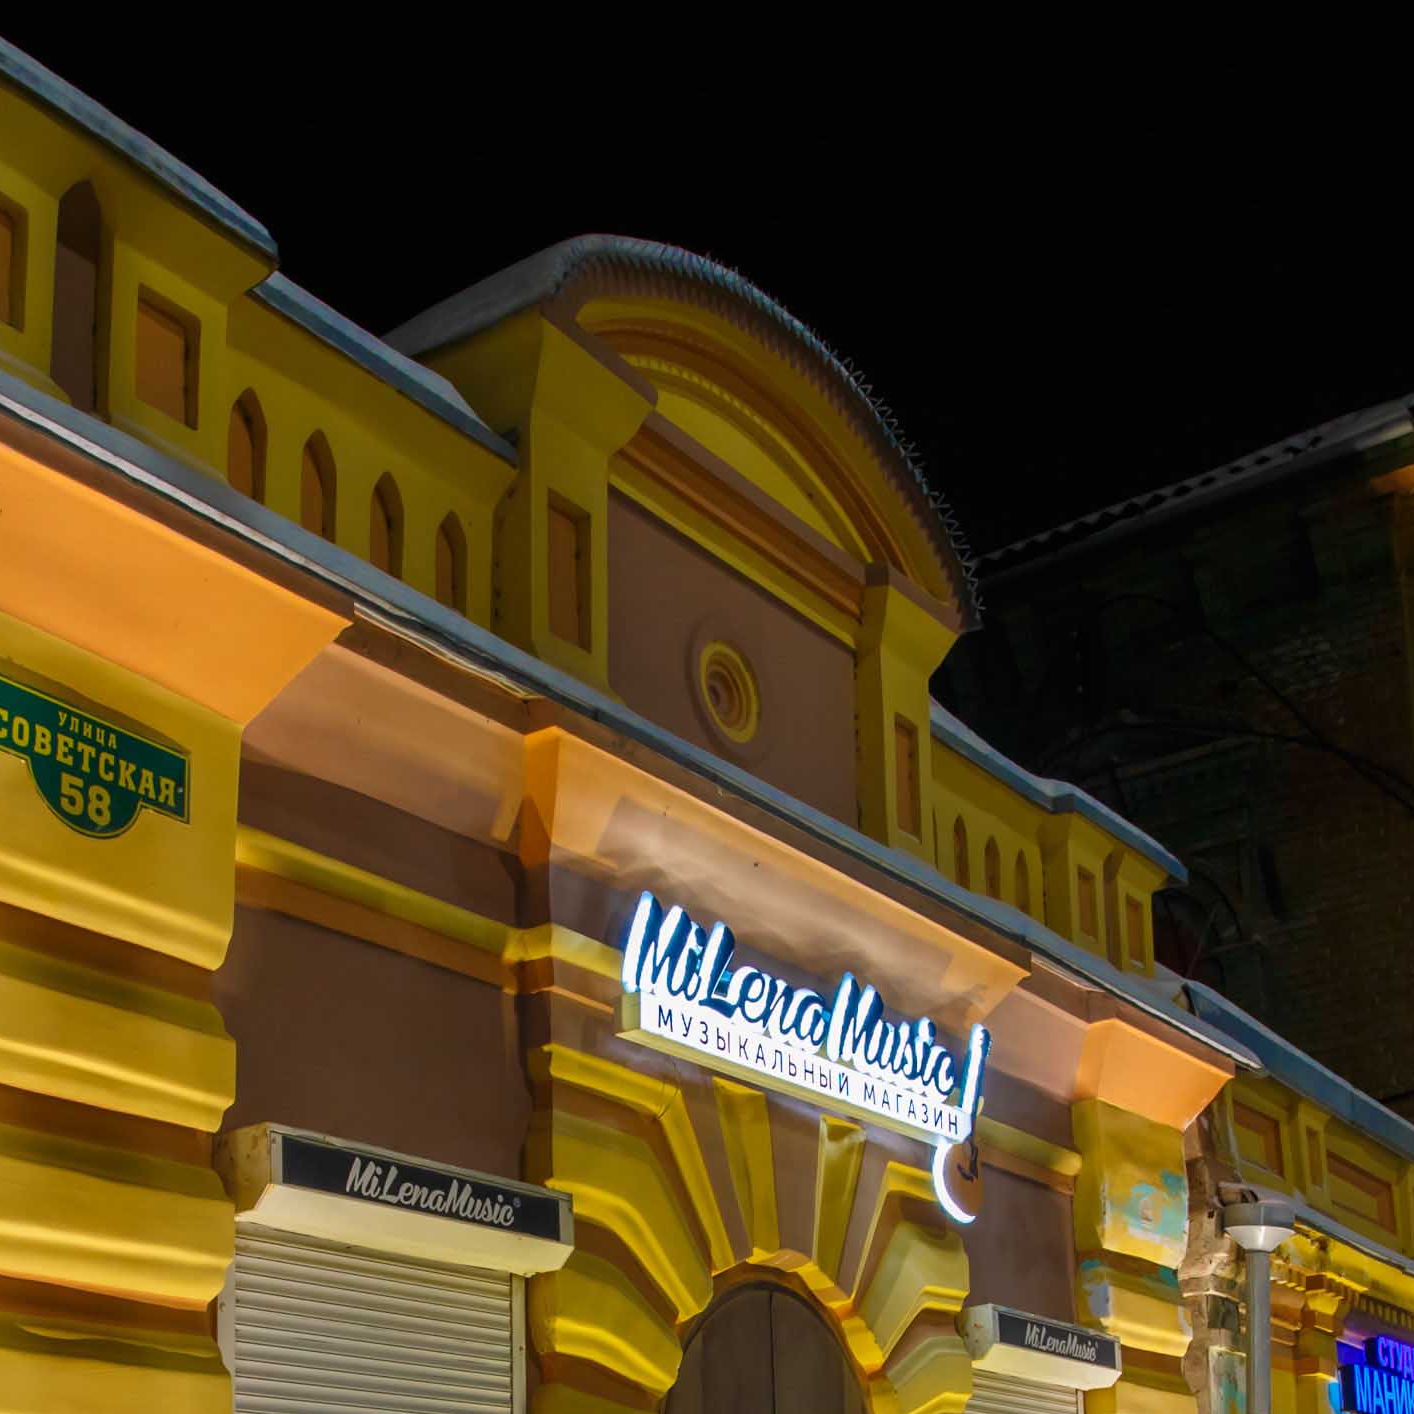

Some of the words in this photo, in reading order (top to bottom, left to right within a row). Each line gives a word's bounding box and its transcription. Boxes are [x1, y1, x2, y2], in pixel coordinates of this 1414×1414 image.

[57, 710, 119, 750] УЛИЦА
[59, 777, 113, 827] 58
[657, 1004, 850, 1097] МУЗЫКАЛЬНЫЙ
[862, 1081, 960, 1136] МАГАЗИН
